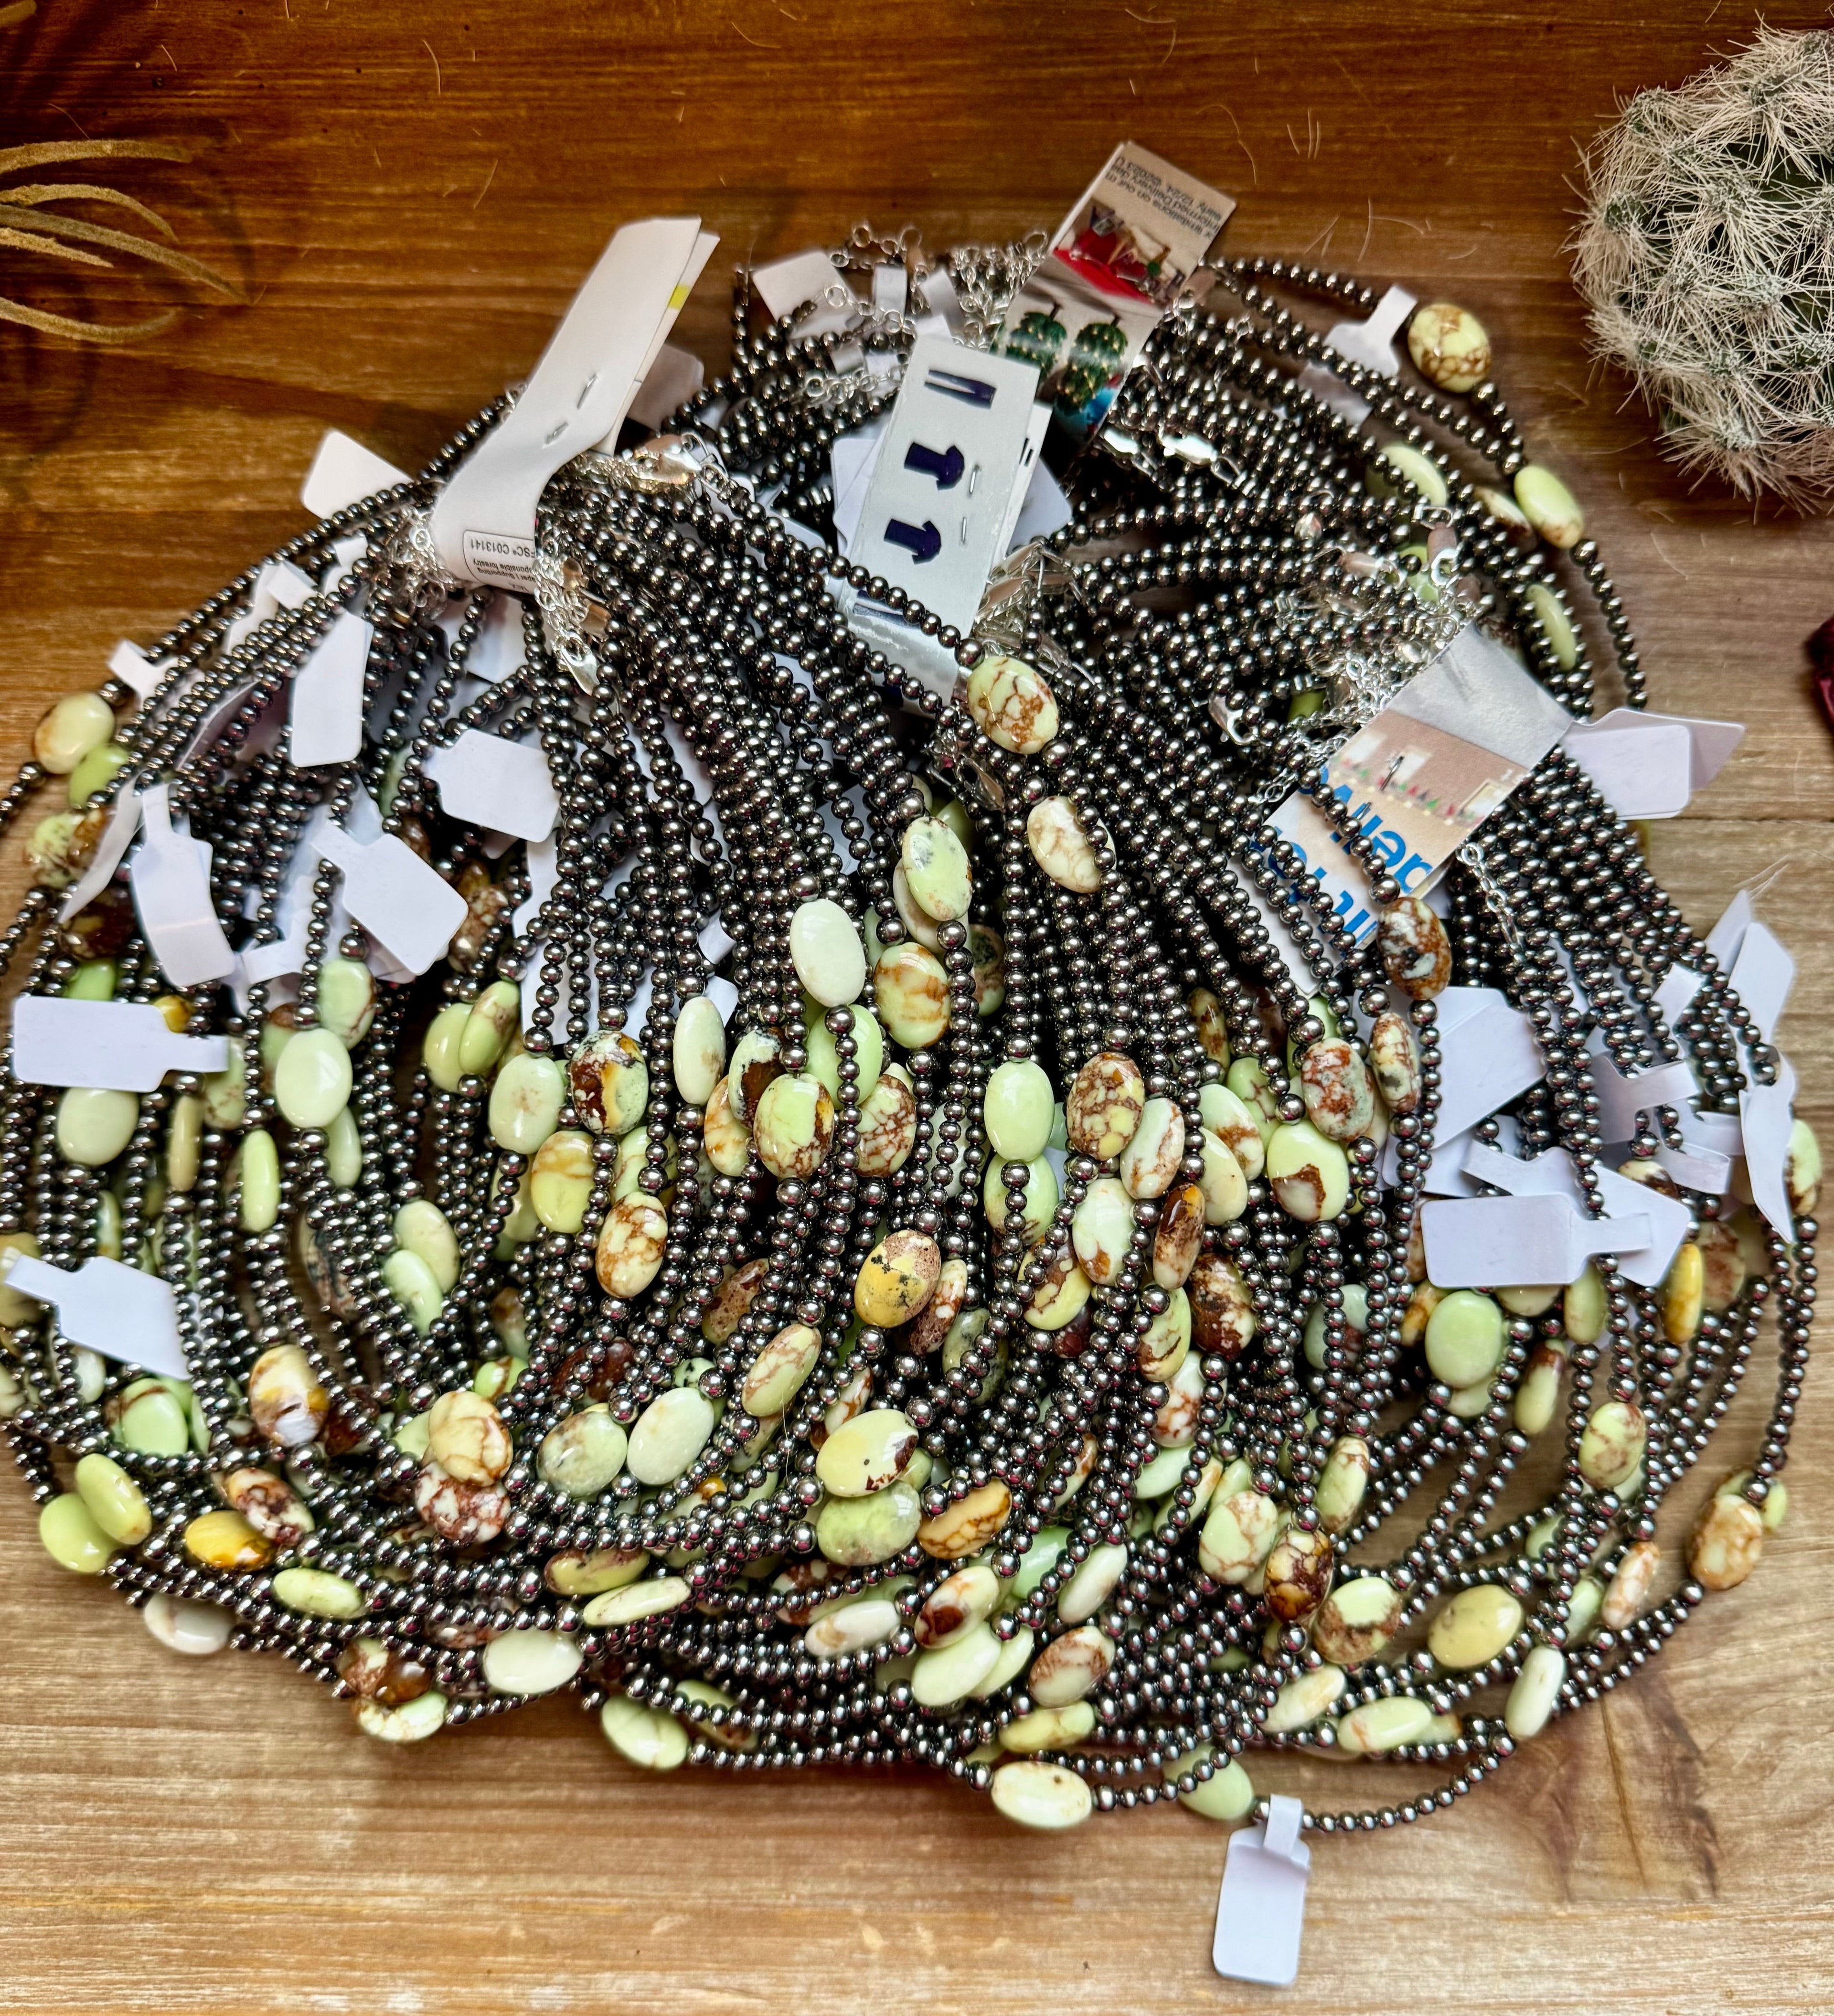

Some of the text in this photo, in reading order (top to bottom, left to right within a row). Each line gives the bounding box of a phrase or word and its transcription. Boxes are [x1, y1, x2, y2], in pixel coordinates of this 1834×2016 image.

[470, 539, 510, 555] C013141
[473, 558, 499, 569] forestry
[477, 567, 515, 579] Supporting
